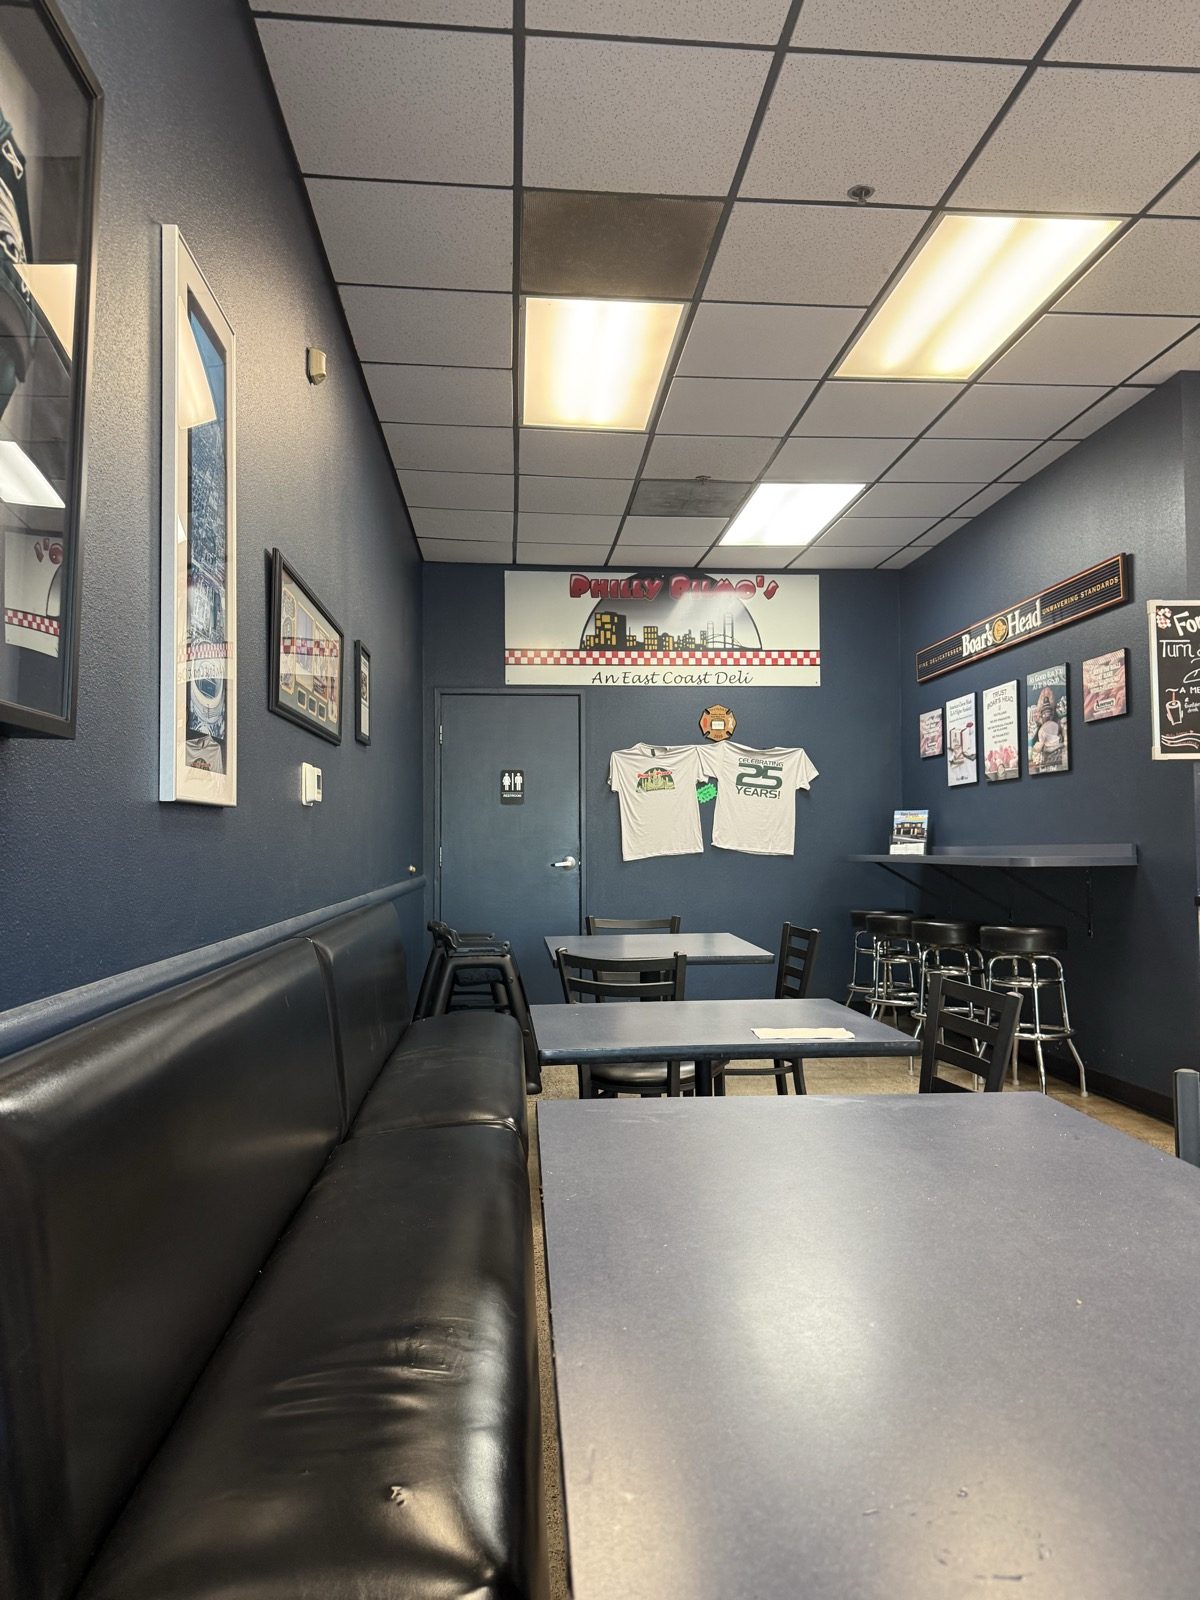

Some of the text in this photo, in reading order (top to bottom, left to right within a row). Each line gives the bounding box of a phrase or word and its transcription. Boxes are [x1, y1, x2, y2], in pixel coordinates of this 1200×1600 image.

[570, 574, 663, 600] PHILLY
[961, 623, 993, 657] Boar's
[1006, 598, 1042, 639] Head
[1041, 594, 1079, 615] UNWAVERING
[1080, 576, 1119, 599] STANDARDS
[592, 670, 753, 685] An East Coast Deli
[1179, 686, 1186, 694] A
[738, 757, 784, 767] CELEBRATING
[736, 762, 783, 790] 25
[736, 785, 781, 800] YEARS!
